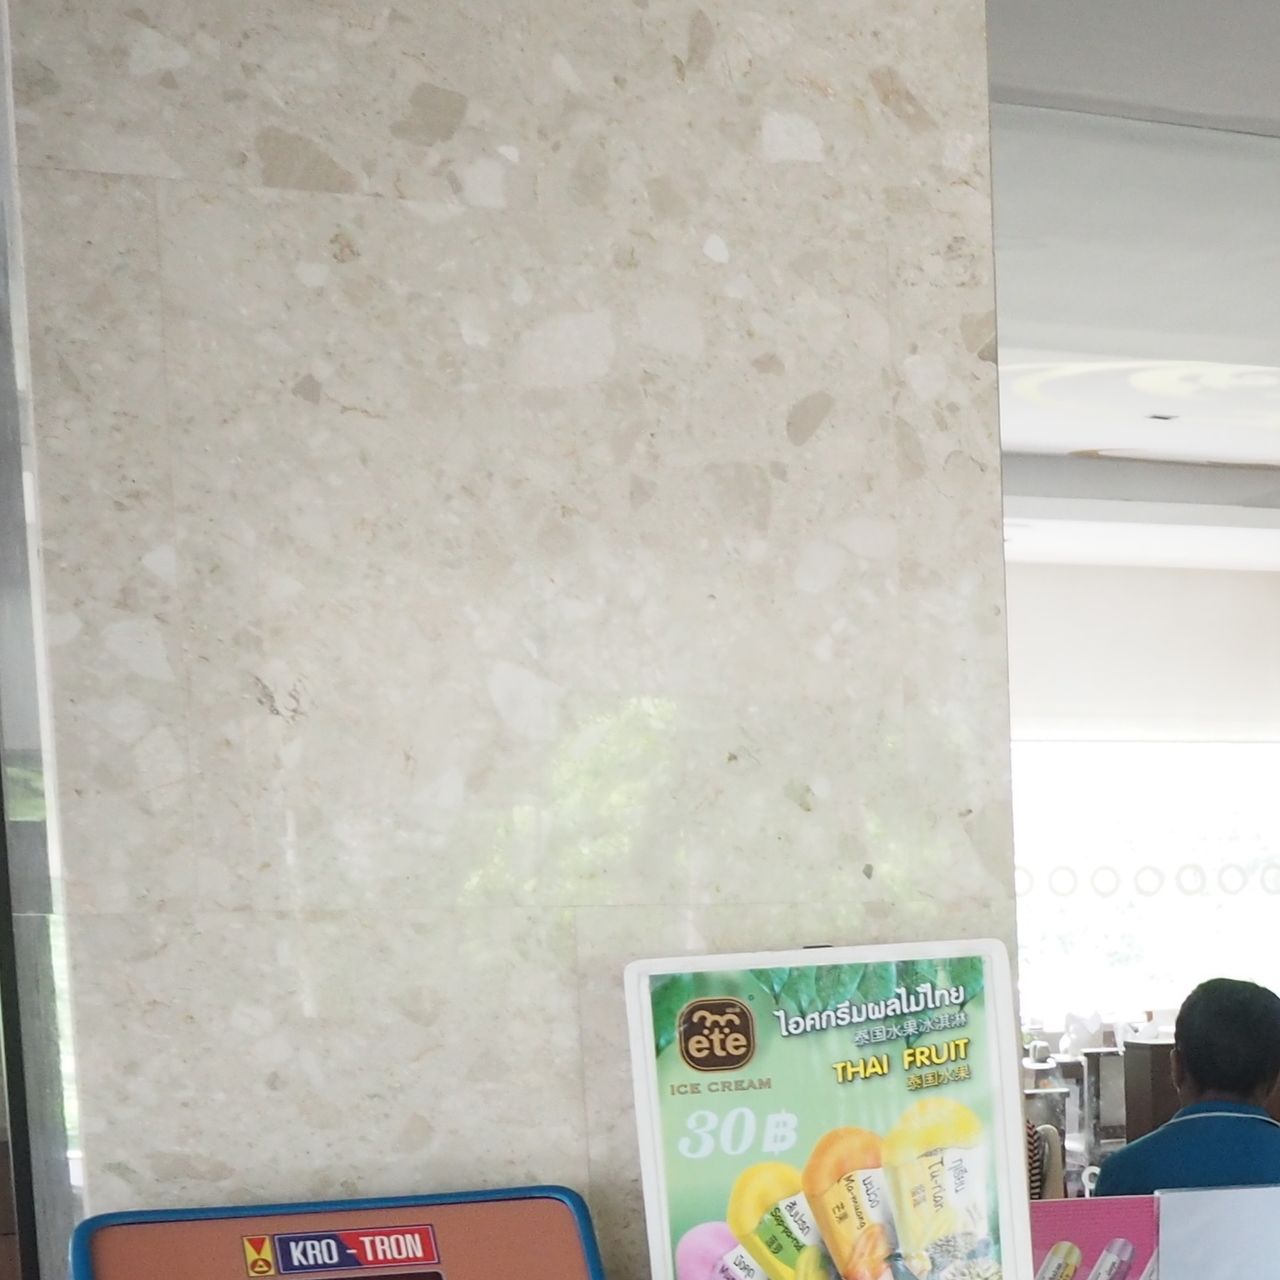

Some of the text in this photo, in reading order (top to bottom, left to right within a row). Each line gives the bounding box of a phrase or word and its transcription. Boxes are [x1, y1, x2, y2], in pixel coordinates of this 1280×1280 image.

[832, 1037, 970, 1085] THAI FRUIT
[670, 1077, 773, 1097] ICE CREAM
[906, 1064, 971, 1092] 泰国水果
